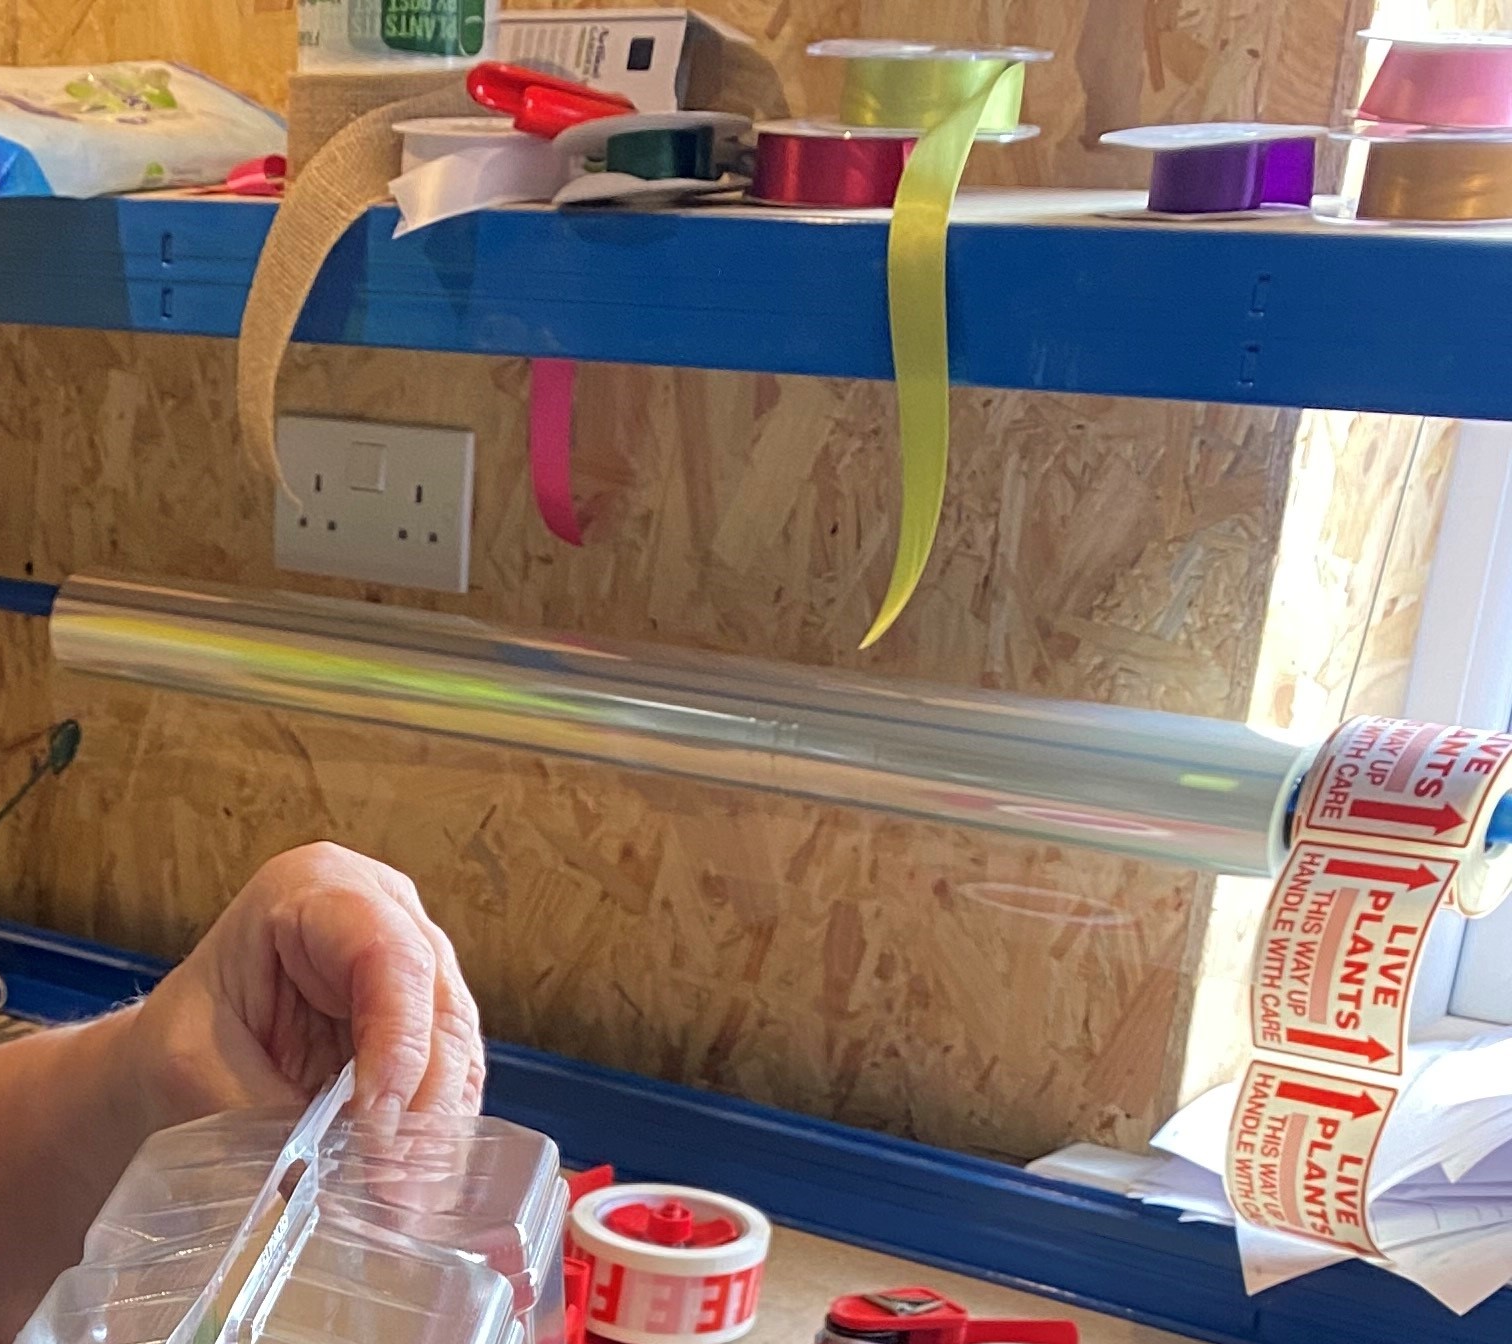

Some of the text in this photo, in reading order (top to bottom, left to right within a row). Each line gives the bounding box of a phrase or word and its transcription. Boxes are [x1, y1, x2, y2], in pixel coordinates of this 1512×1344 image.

[385, 13, 458, 41] PLANTS
[1319, 725, 1384, 820] WITH CARE
[1365, 759, 1394, 787] UP
[1379, 728, 1418, 757] WAY
[1413, 728, 1478, 799] ANTS
[1464, 732, 1512, 775] IVE
[1260, 852, 1325, 1044] HANDLE WITH CARE
[1287, 889, 1336, 1018] THIS WAY UP
[1335, 889, 1395, 1030] PLANTS
[1373, 924, 1418, 1008] LIVE
[1237, 1072, 1275, 1155] HANDLE
[1235, 1159, 1256, 1202] WITH
[1259, 1115, 1288, 1222] THIS WAY UP
[1303, 1116, 1341, 1237] PLANTS
[1335, 1153, 1364, 1228] LIVE
